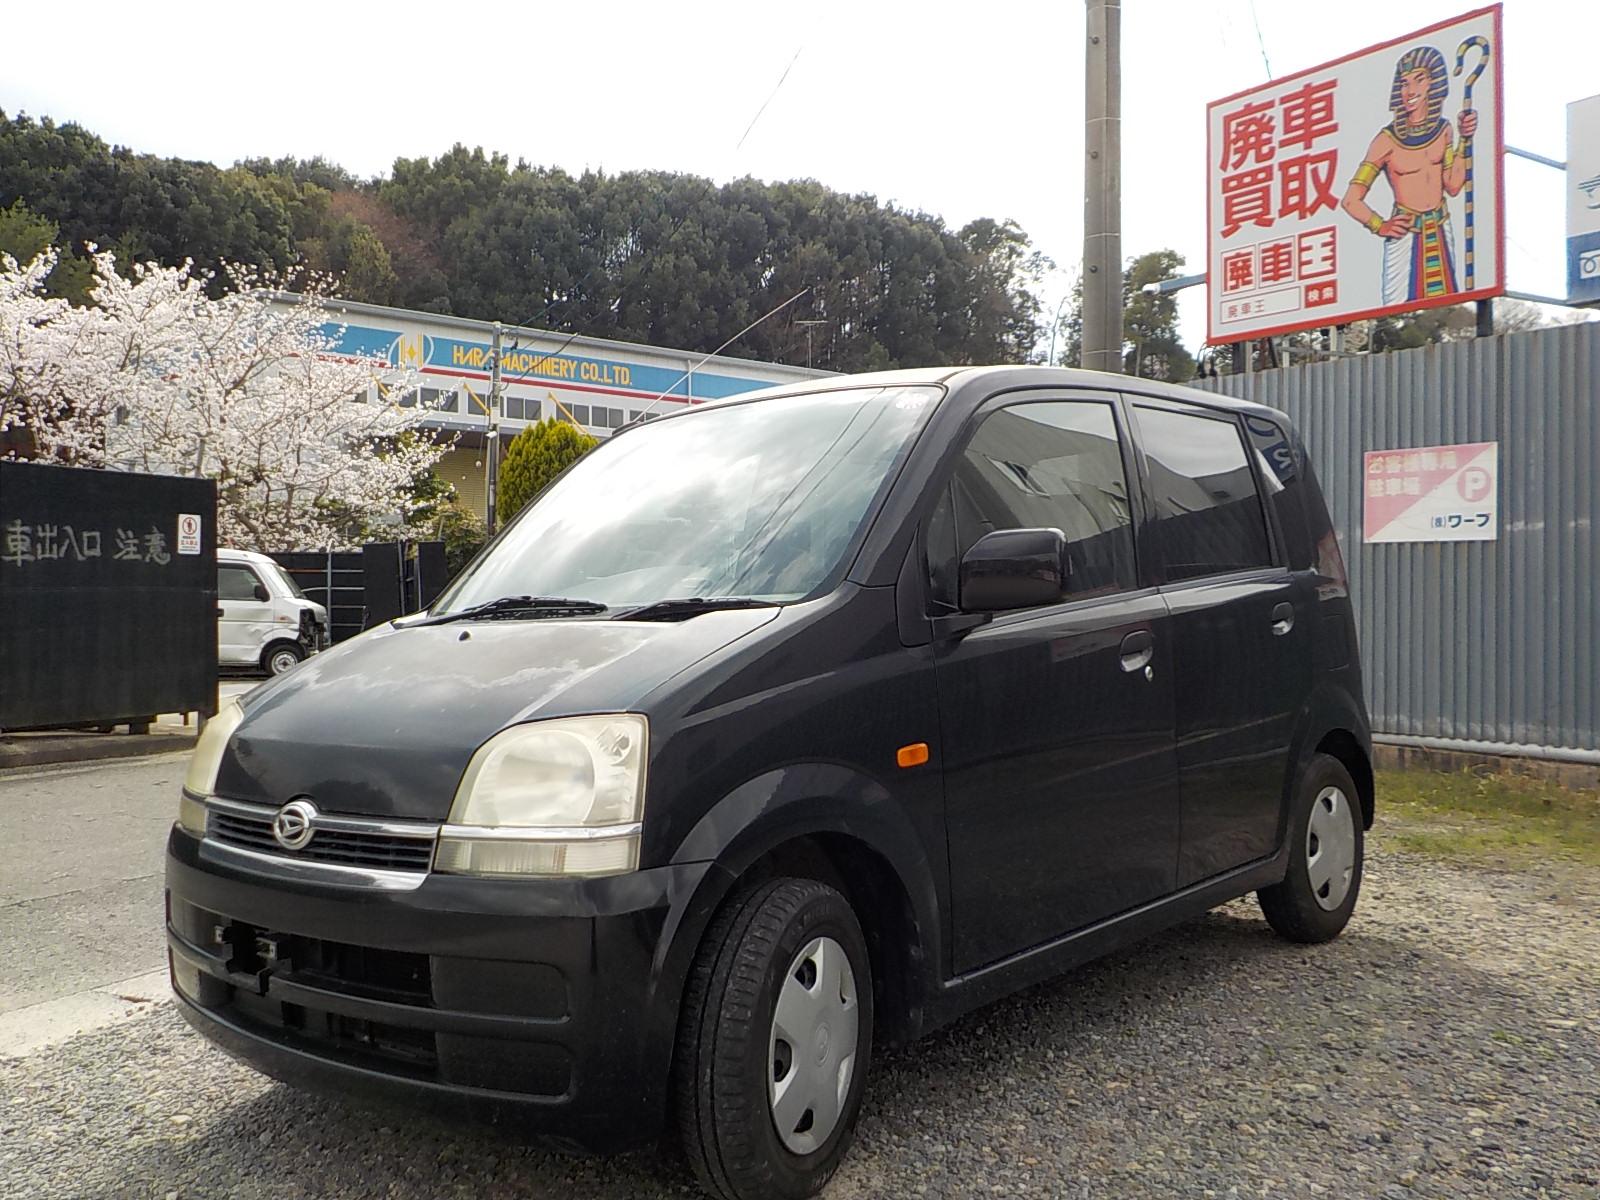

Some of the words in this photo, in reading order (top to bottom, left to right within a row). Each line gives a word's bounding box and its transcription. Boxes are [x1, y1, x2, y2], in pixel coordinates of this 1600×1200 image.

[1219, 78, 1339, 173] 廃車
[1220, 148, 1340, 239] 買取
[502, 351, 577, 379] MACHINERY
[1, 518, 101, 567] 車出入口
[112, 526, 171, 565] 注意
